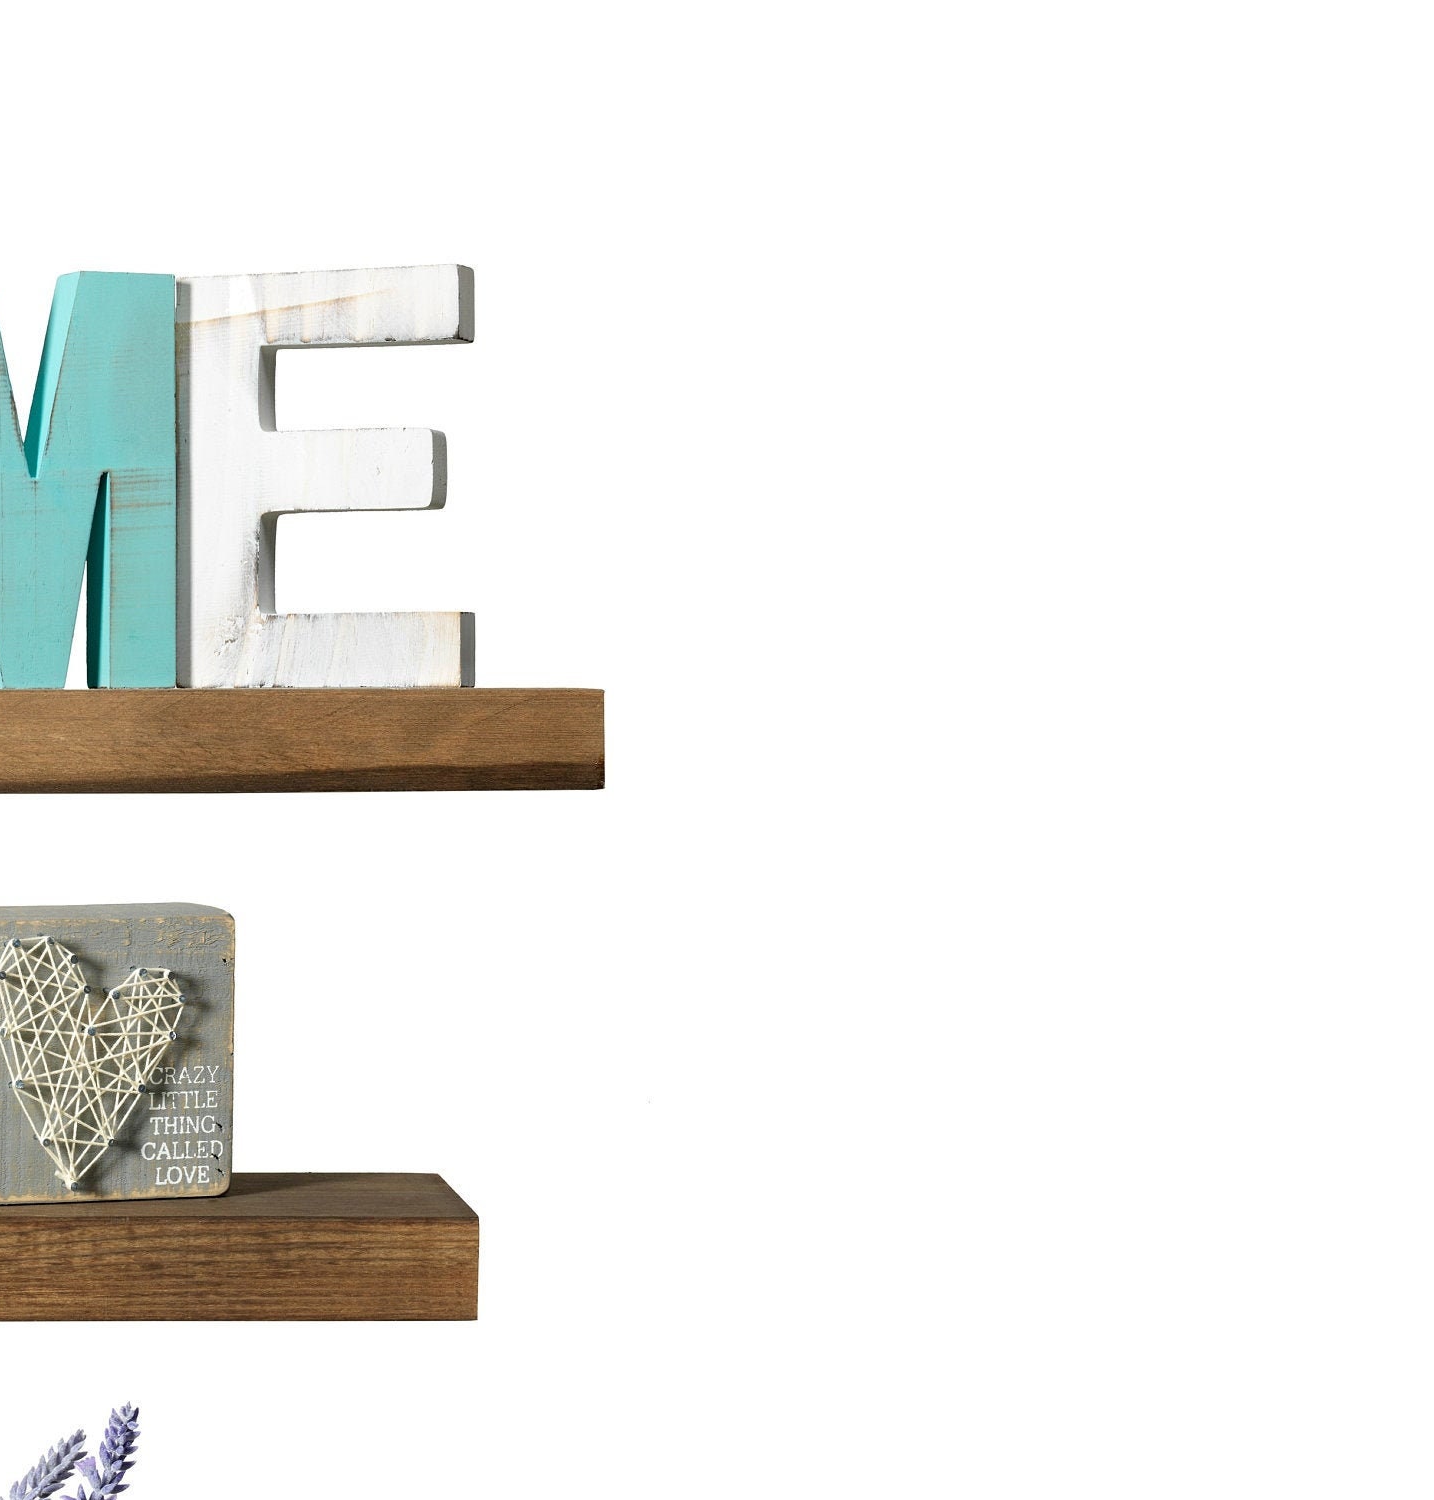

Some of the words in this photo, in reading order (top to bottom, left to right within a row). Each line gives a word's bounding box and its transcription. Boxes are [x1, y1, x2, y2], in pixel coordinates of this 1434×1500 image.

[149, 1065, 220, 1085] CRAZY
[148, 1090, 218, 1110] LITTLE
[149, 1115, 216, 1135] THING
[140, 1140, 224, 1161] CALLED
[154, 1165, 210, 1186] LOVE
